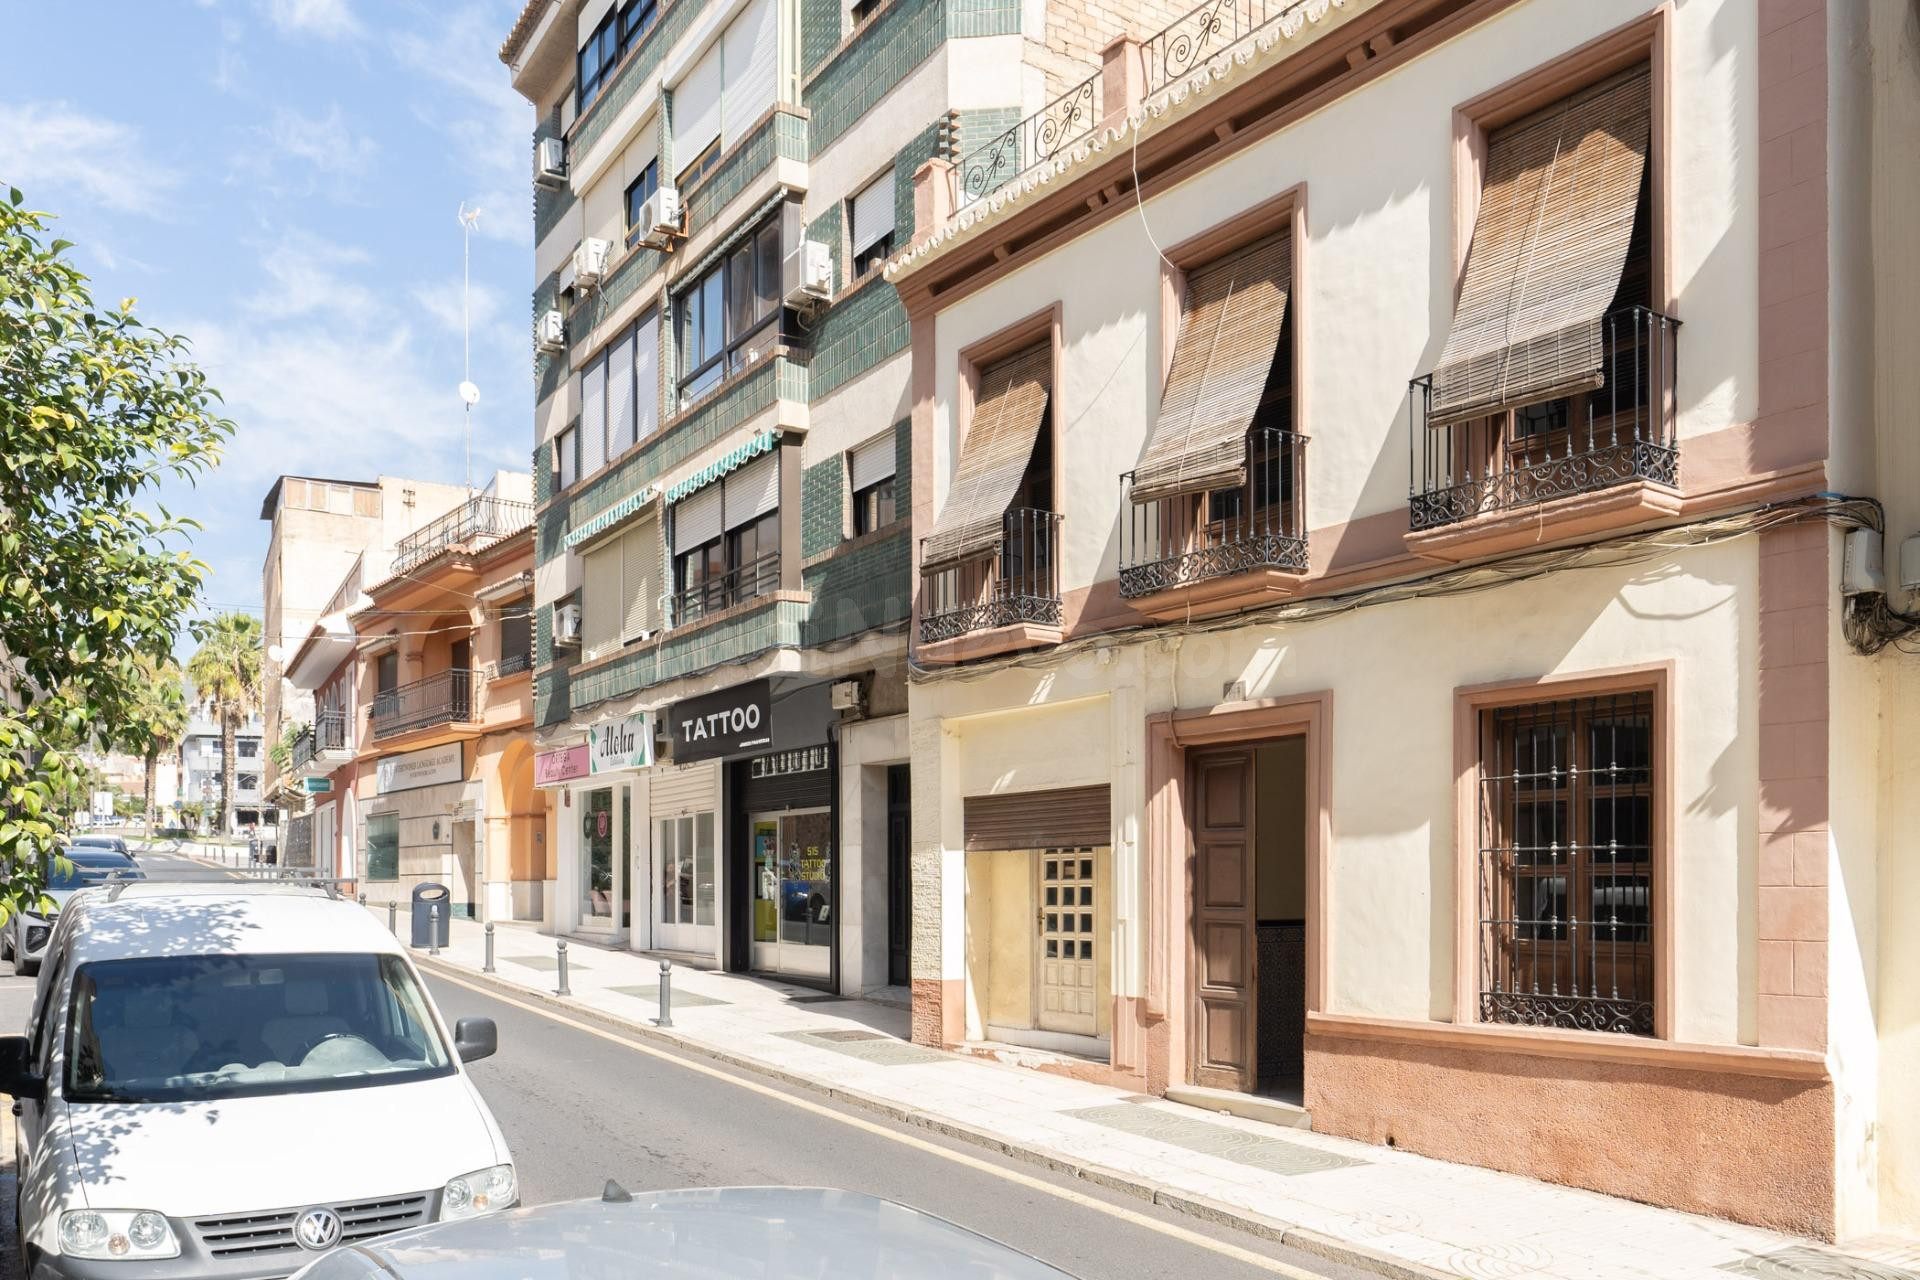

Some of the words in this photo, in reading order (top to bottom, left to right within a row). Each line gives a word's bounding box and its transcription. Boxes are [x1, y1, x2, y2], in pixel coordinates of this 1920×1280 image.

[682, 703, 760, 742] TATTOO
[600, 723, 634, 757] Aloha
[800, 858, 826, 869] TATTOO
